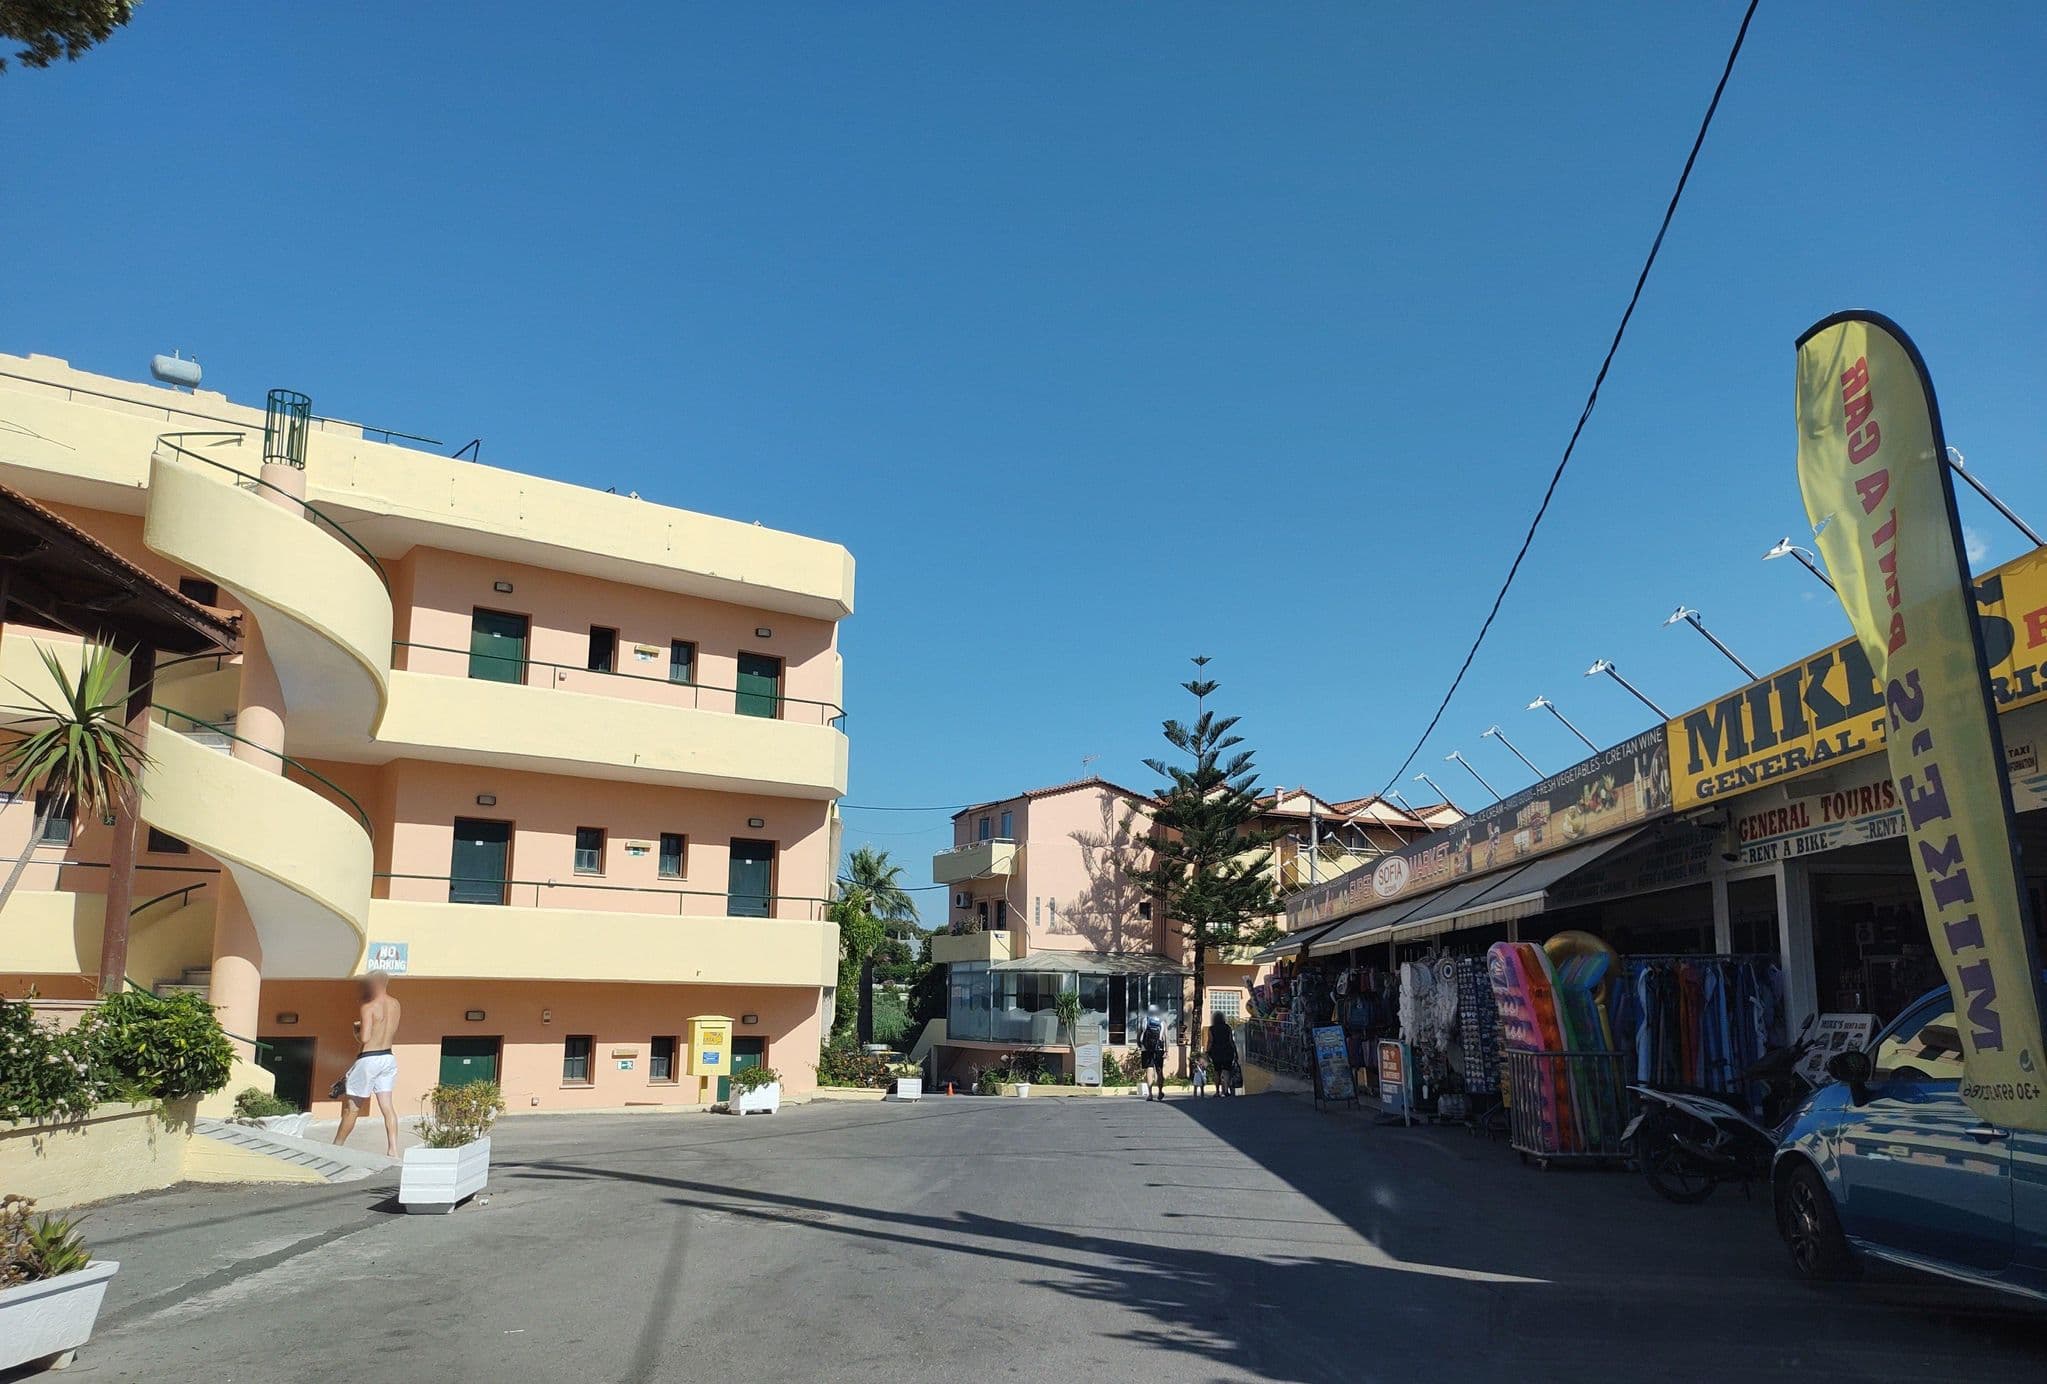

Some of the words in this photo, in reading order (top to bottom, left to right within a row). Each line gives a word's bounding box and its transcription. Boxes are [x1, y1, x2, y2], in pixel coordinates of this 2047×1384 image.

[1536, 777, 1555, 797] FRESH
[1556, 757, 1601, 787] VEGETABLES
[1605, 740, 1638, 765] CRETAN
[1638, 727, 1663, 750] WINE
[1695, 729, 1866, 799] GENERAL
[2007, 744, 2031, 758] TAXI
[1738, 801, 1810, 842] GENERAL
[1820, 779, 1903, 823] TOURIS
[1869, 819, 1898, 840] RENT
[1749, 844, 1778, 863] RENT
[1783, 841, 1791, 857] A
[1796, 832, 1828, 853] BIKE
[1378, 861, 1403, 886] SOFIA
[1408, 841, 1450, 884] MARKET
[368, 959, 406, 971] PARKING
[380, 945, 397, 959] NO
